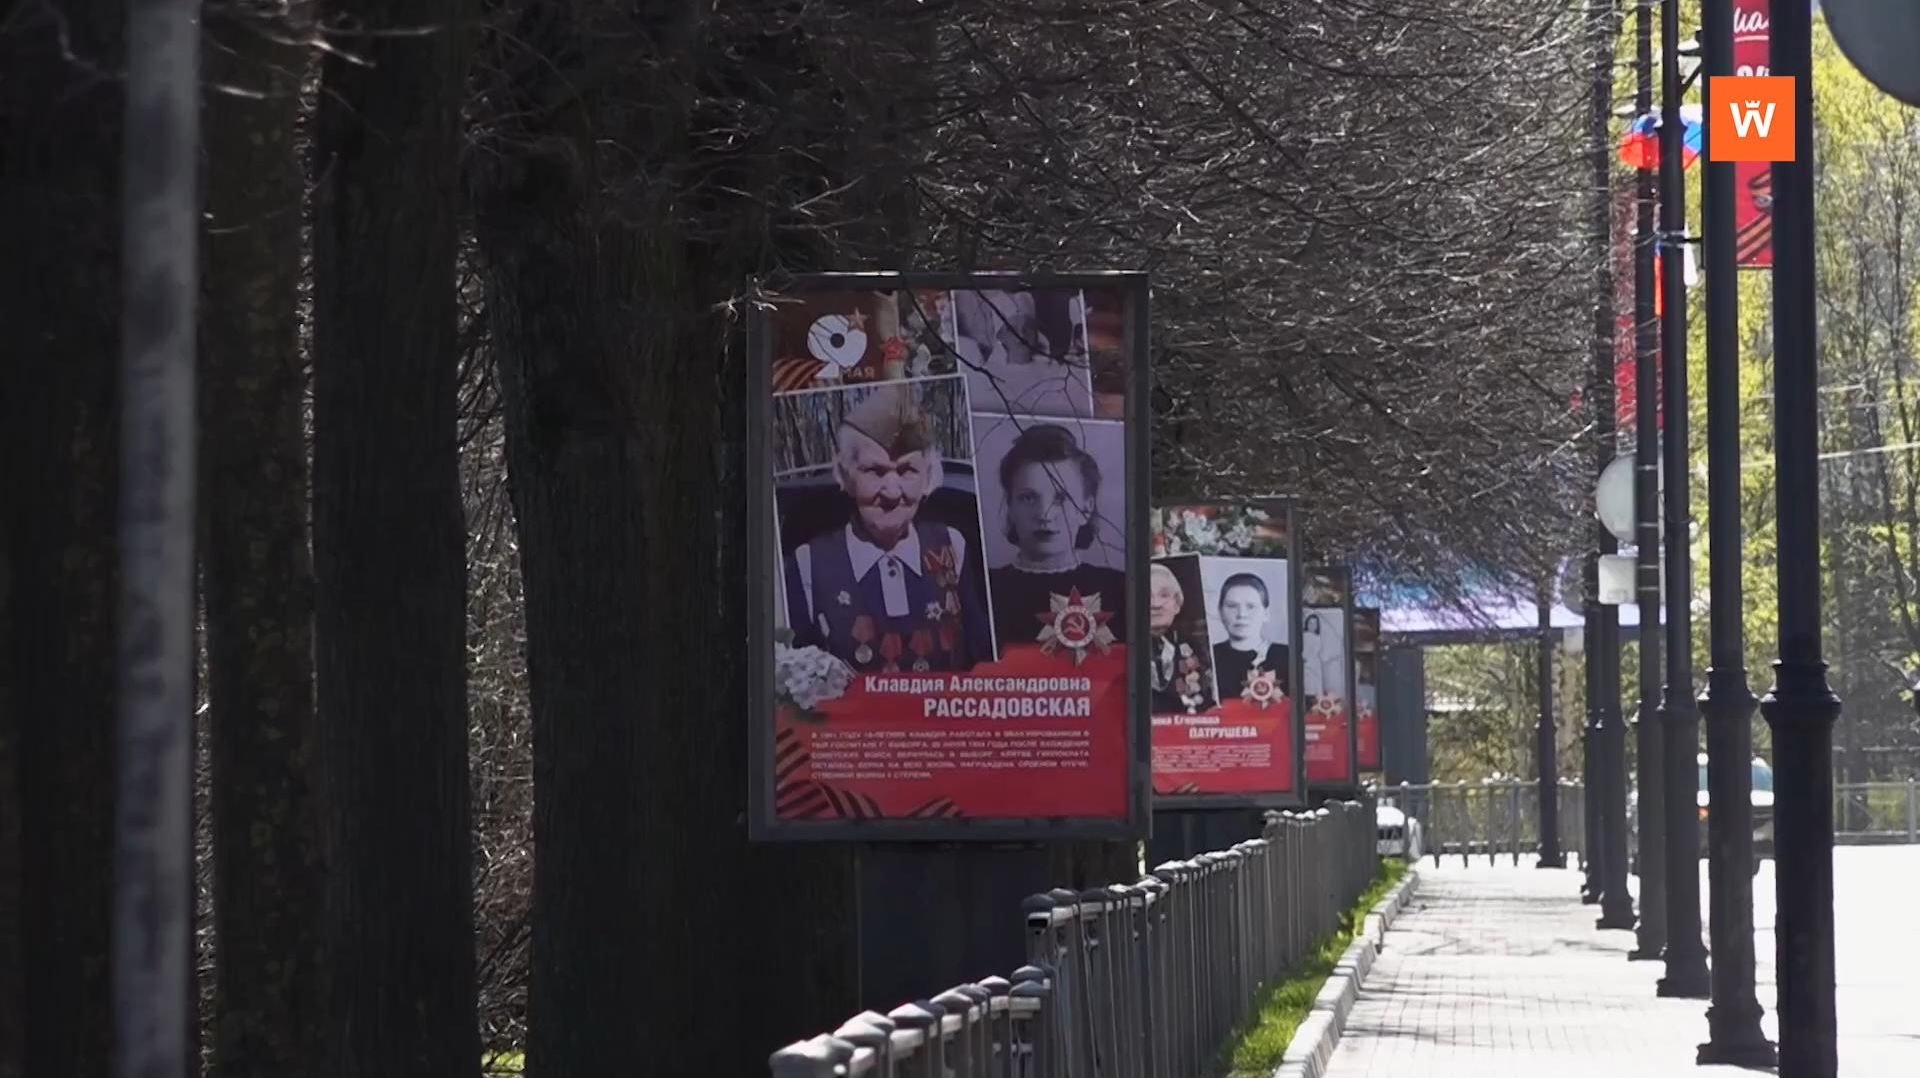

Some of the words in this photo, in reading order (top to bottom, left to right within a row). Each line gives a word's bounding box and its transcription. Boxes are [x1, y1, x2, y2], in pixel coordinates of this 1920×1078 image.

[865, 676, 945, 694] Клавдия
[950, 675, 1091, 693] Александровна
[923, 697, 1091, 719] РАССАДОВСКАЯ
[1189, 726, 1258, 739] ПАТРУШЕВА
